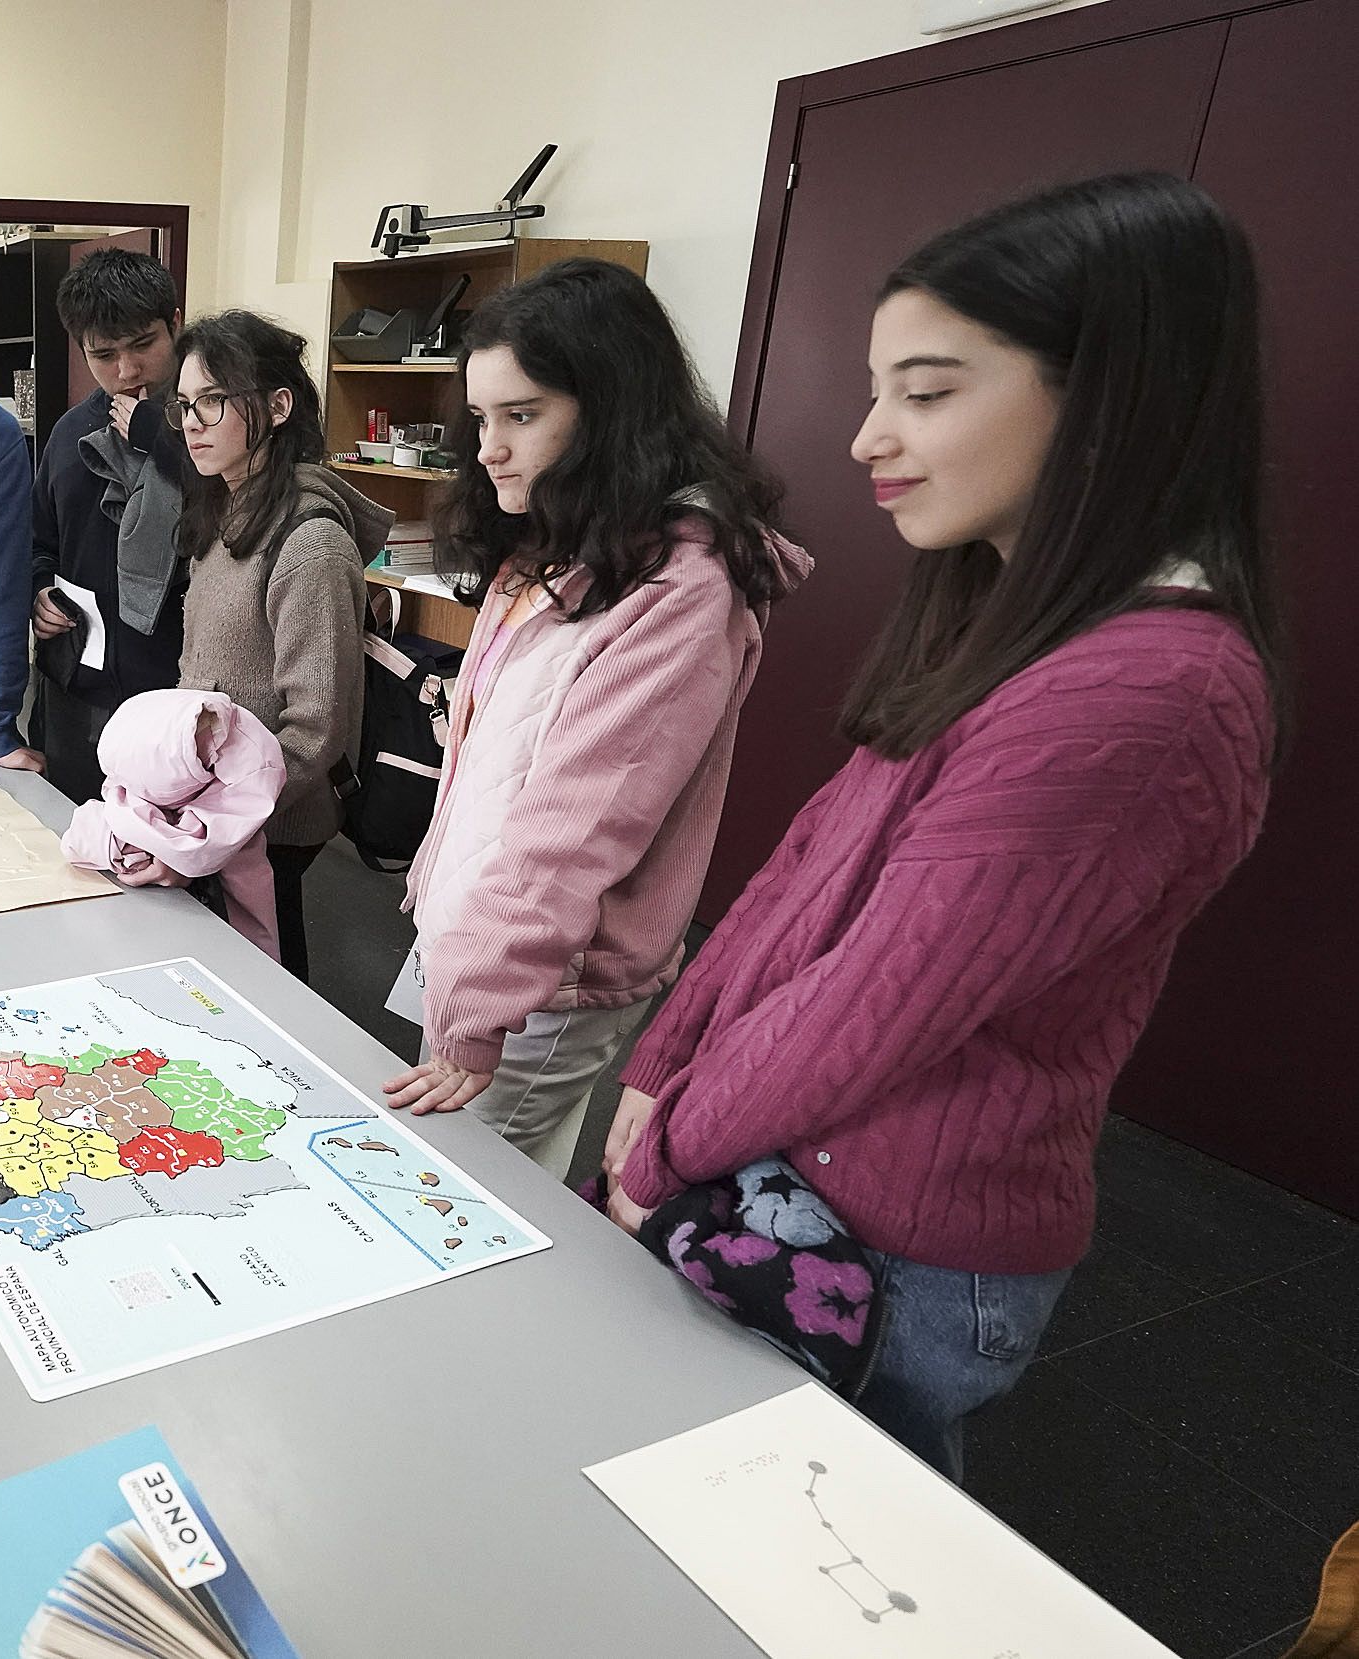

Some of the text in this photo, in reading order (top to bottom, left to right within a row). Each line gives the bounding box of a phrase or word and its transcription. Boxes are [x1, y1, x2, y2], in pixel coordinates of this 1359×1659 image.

[189, 990, 216, 1008] ONCE
[79, 1138, 89, 1146] AV
[138, 1145, 151, 1154] CC
[1, 1161, 15, 1173] CYL
[87, 1160, 98, 1168] SA
[354, 1170, 368, 1178] LS
[31, 1180, 42, 1188] LE
[126, 1176, 164, 1213] PORTUGAL
[363, 1189, 378, 1198] SC
[325, 1201, 376, 1243] CANARIAS
[50, 1248, 70, 1266] GAL
[168, 1266, 192, 1289] 200 km
[0, 1264, 77, 1373] PROVINCIAL DE ESPAÑA
[33, 1343, 58, 1371] MAPA
[144, 1472, 198, 1544] ONCE
